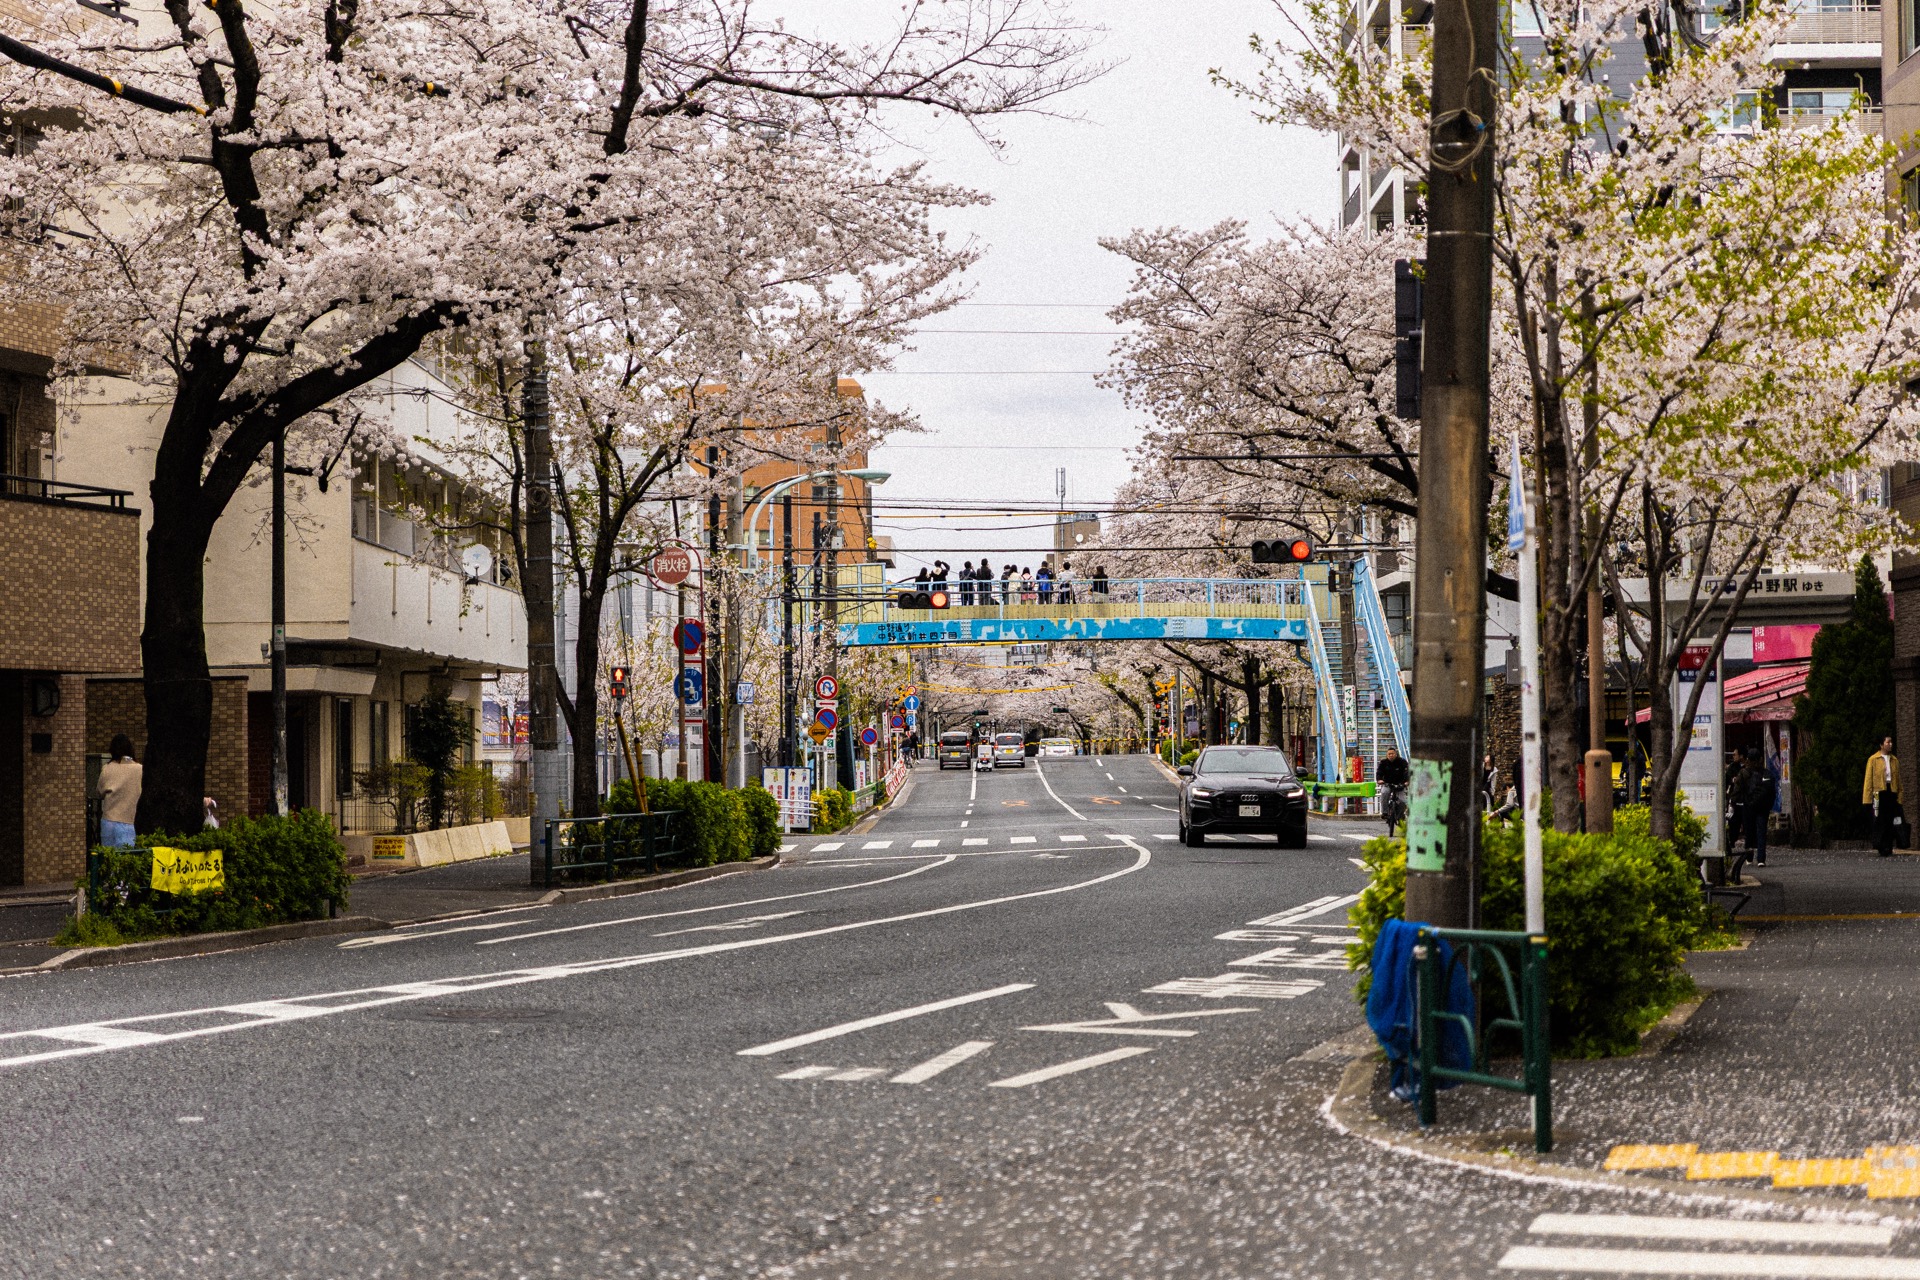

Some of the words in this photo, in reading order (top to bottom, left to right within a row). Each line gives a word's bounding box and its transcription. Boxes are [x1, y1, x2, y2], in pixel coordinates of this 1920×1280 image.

[656, 557, 688, 573] 消火栓
[1750, 578, 1798, 593] 中野駅
[1802, 580, 1824, 592] ゆき
[878, 623, 910, 633] 中野通り
[878, 631, 958, 641] 中野区新井四丁目
